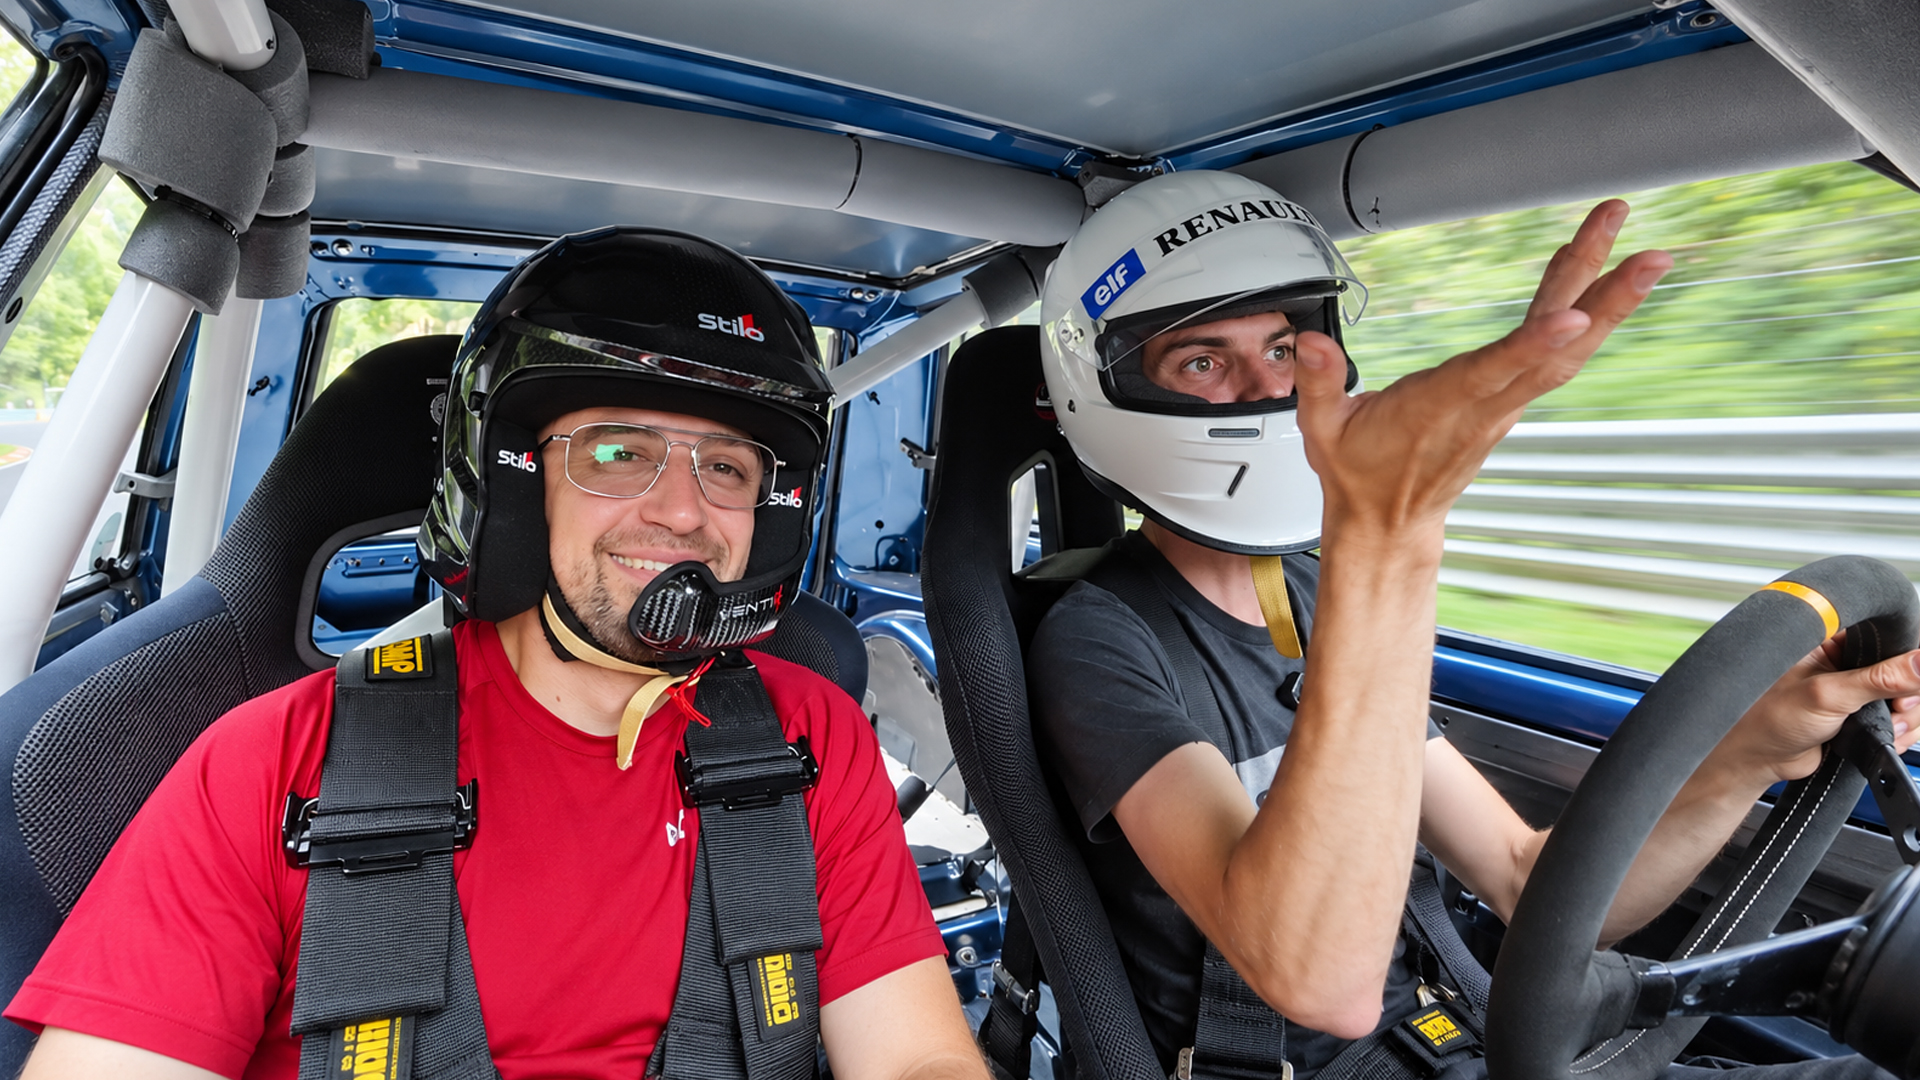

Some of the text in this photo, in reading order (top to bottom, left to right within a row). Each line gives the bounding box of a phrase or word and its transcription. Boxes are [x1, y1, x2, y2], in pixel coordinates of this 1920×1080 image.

[1153, 200, 1315, 257] RENAULT
[1094, 262, 1129, 306] elf
[697, 313, 765, 342] Stilo
[497, 449, 537, 473] Stilo
[768, 487, 803, 508] Stilo
